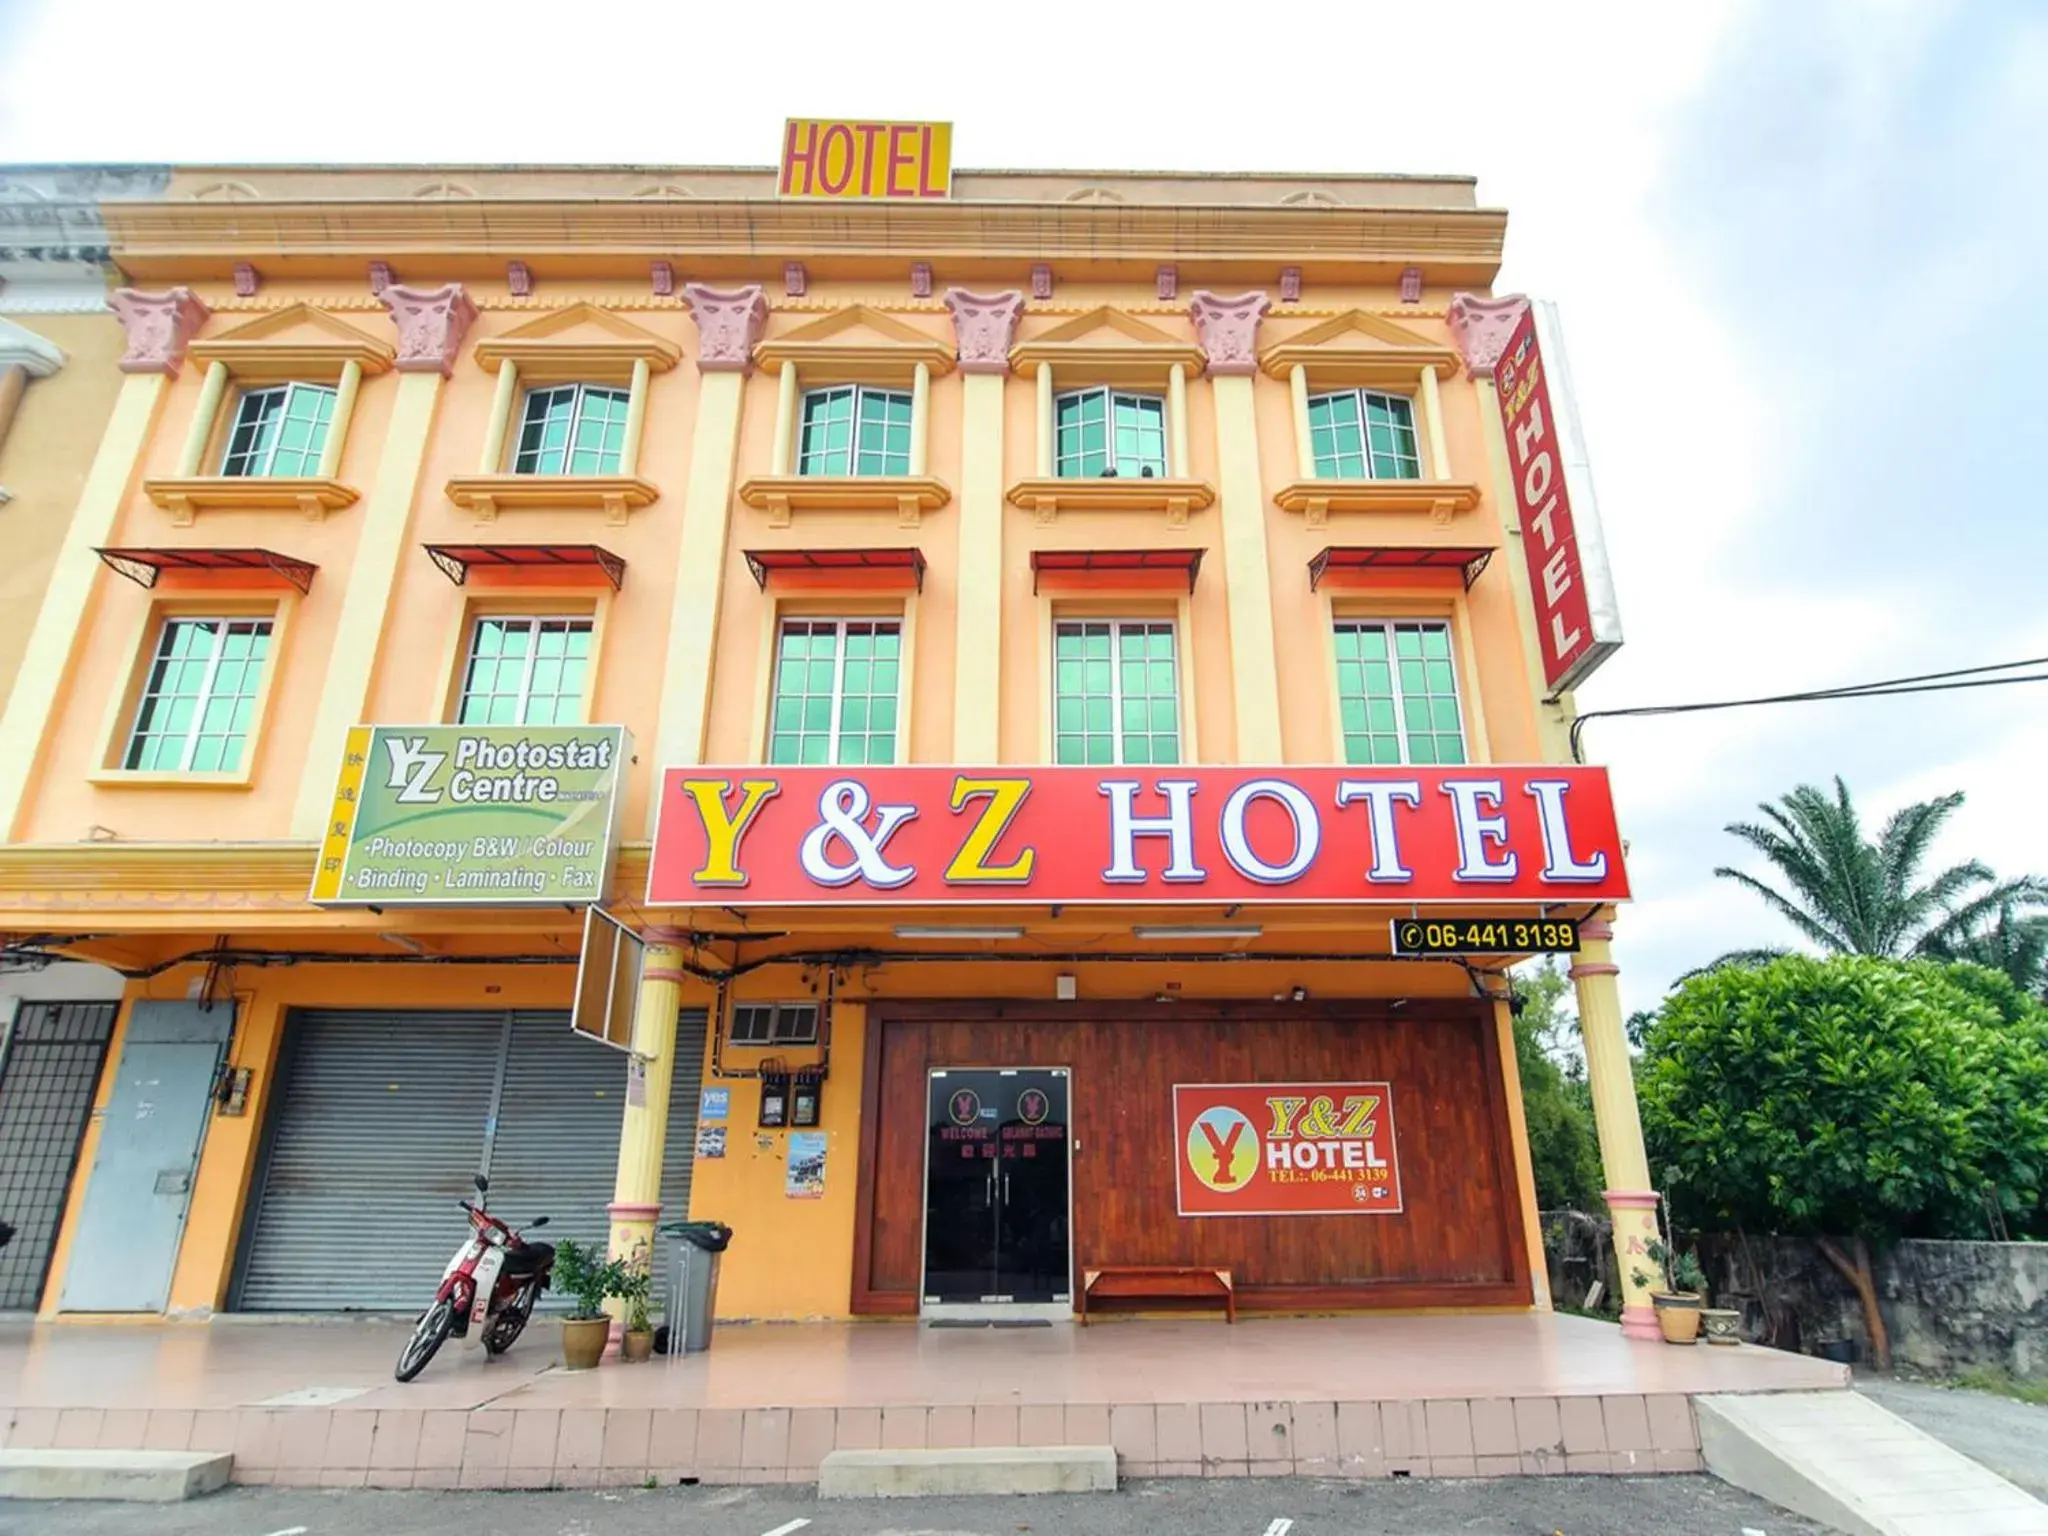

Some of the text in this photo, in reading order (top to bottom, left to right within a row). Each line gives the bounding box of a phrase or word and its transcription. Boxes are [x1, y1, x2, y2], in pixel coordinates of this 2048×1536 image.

[782, 122, 947, 196] HOTEL
[1515, 397, 1581, 660] HOTEL
[454, 737, 612, 769] Photostat
[384, 736, 448, 803] YZ
[450, 770, 559, 802] Centre
[1097, 778, 1607, 885] HOTEL
[369, 837, 469, 862] Photocopy
[472, 837, 518, 857] B&W
[532, 838, 594, 858] Colour
[357, 867, 595, 893] Binding Laminating Fax
[1426, 924, 1573, 947] 06-441 3139
[1266, 1096, 1380, 1138] Y&Z
[1266, 1141, 1386, 1169] HOTEL
[1311, 1168, 1352, 1183] 06-441
[1357, 1168, 1388, 1182] 3139
